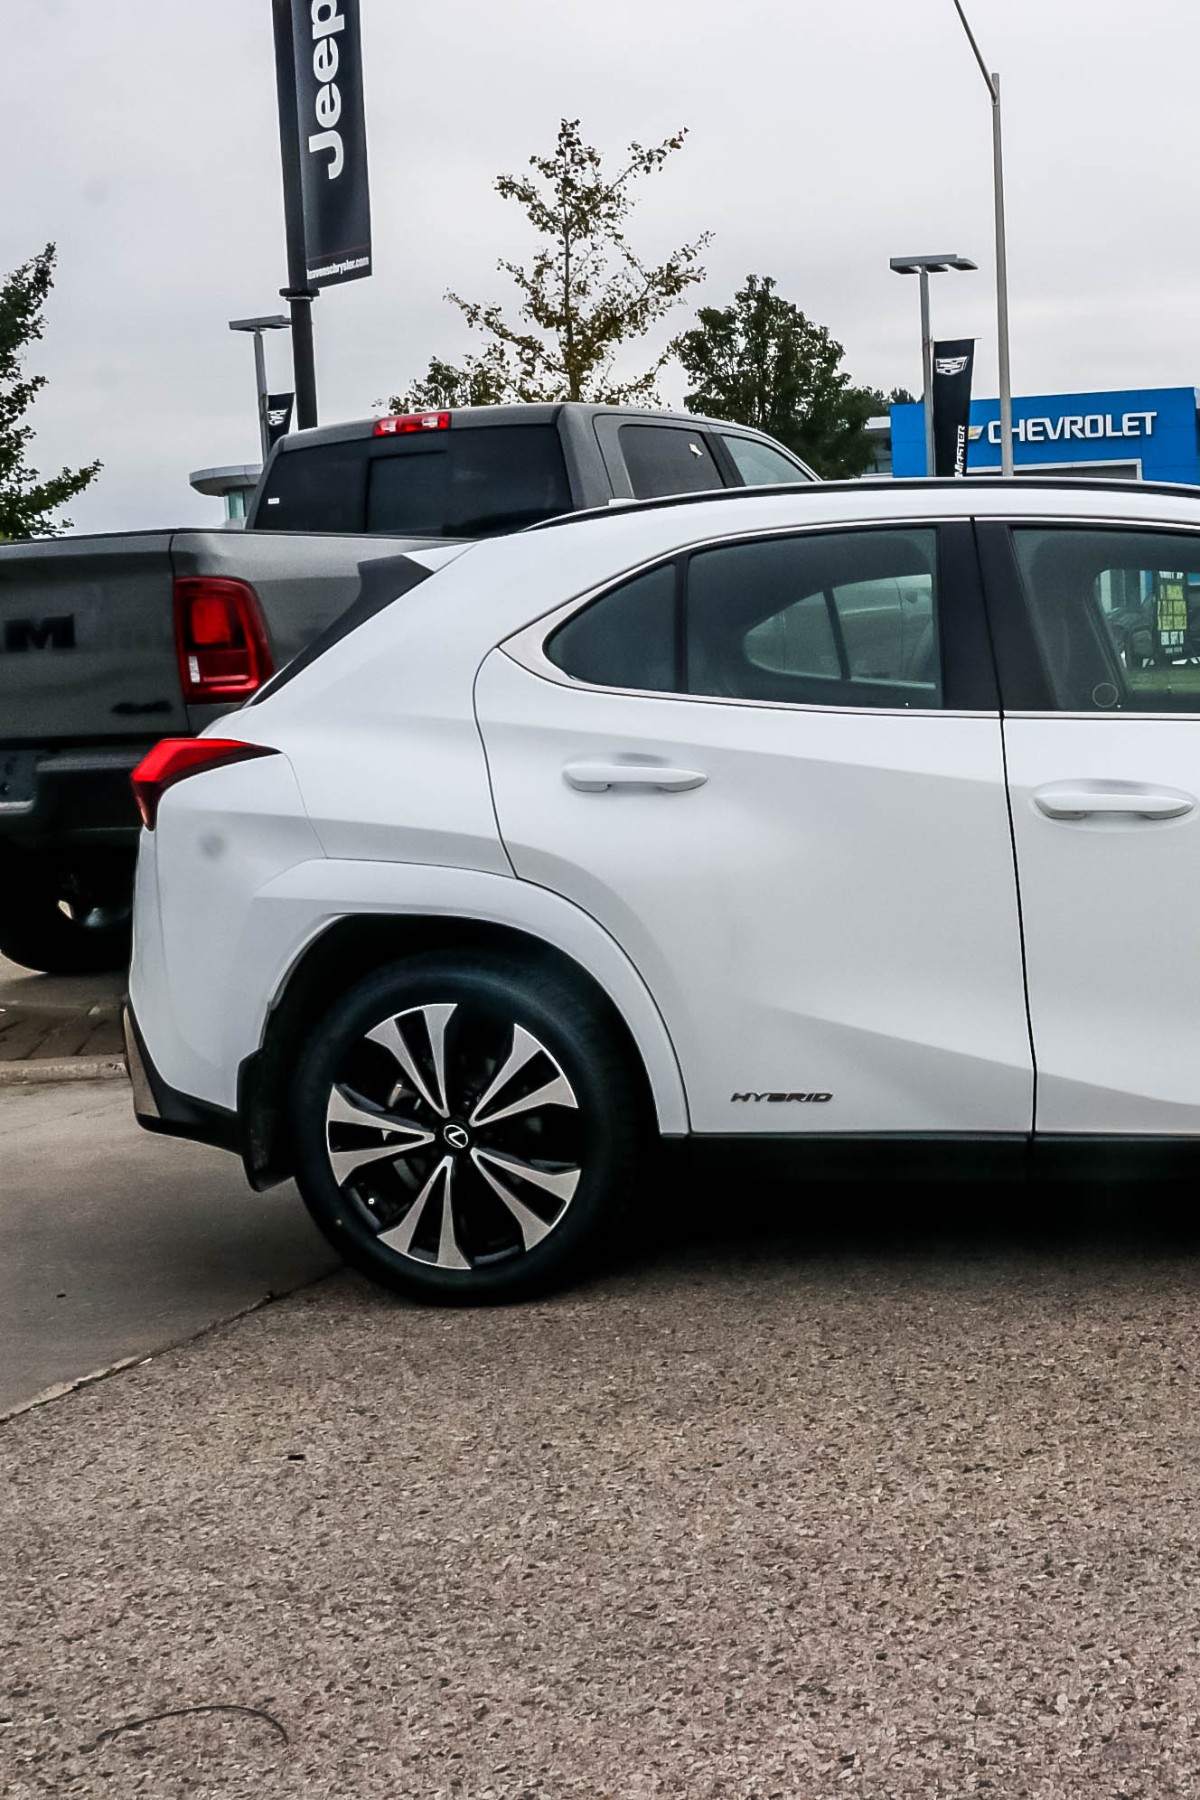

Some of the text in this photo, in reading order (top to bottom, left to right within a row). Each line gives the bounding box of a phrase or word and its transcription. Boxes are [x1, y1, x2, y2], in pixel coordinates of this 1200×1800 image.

[308, 0, 345, 180] Jeep
[987, 411, 1158, 444] CHEVROLET
[730, 1092, 834, 1103] HYBRID
